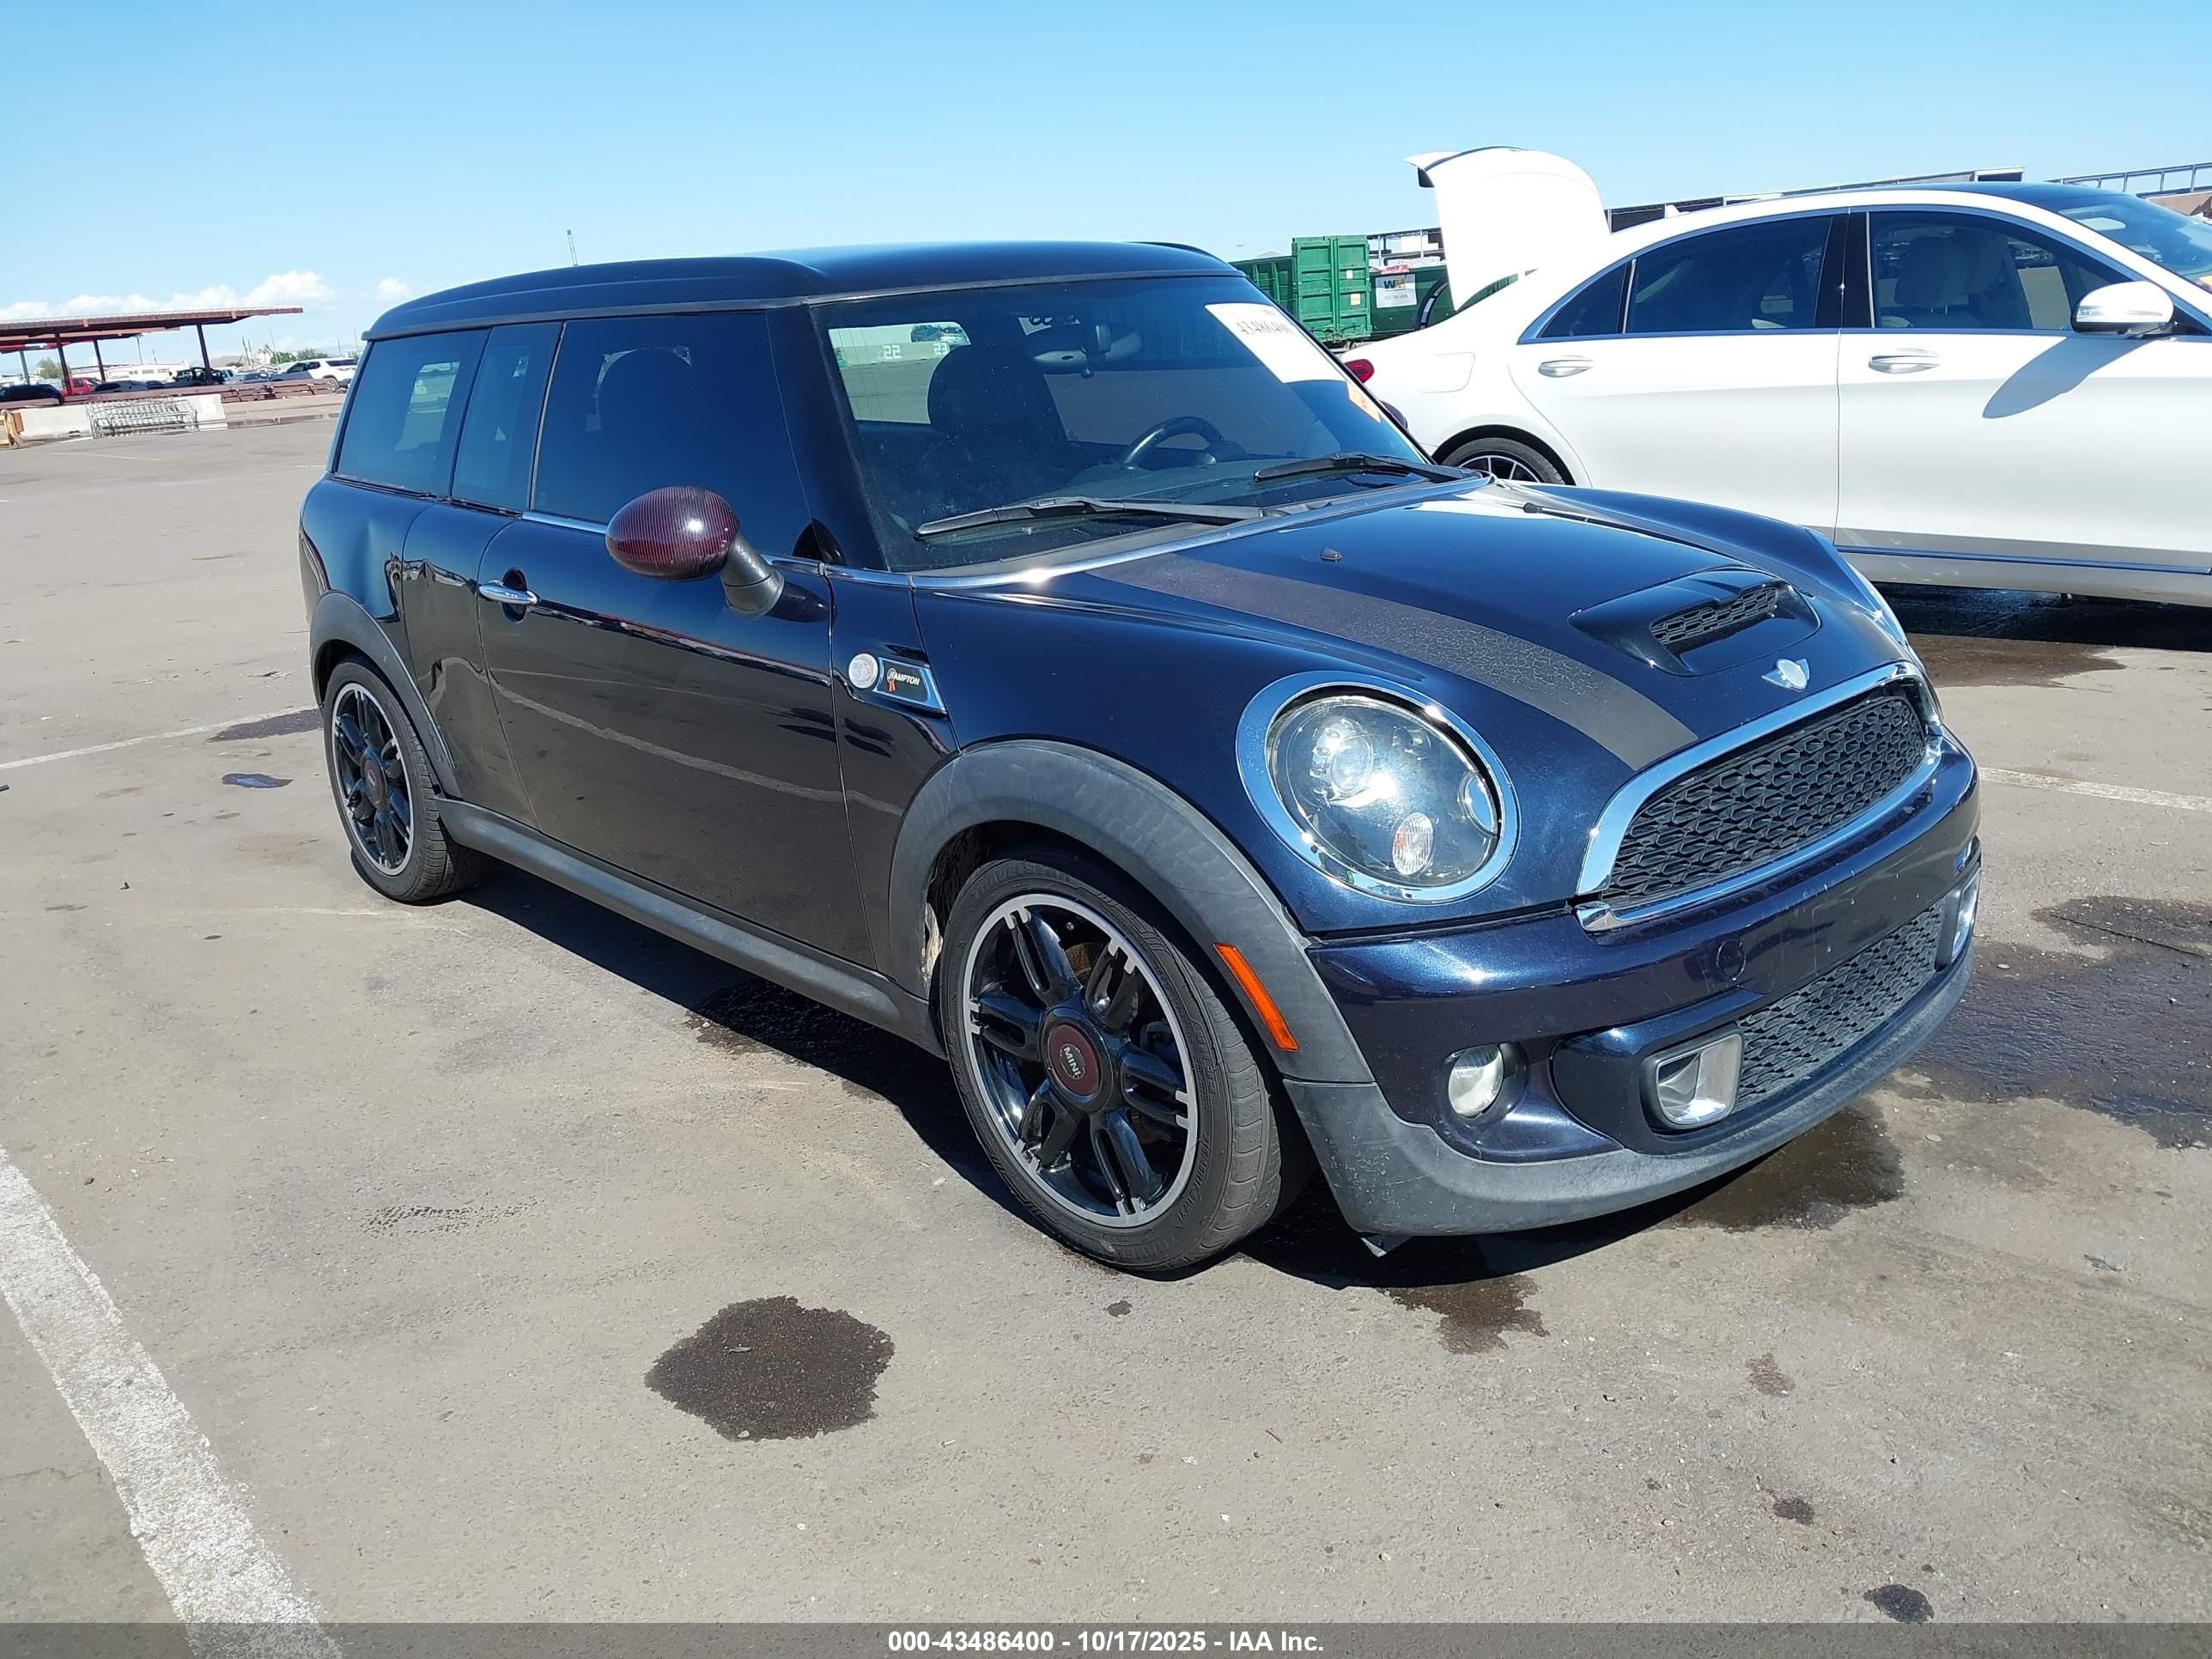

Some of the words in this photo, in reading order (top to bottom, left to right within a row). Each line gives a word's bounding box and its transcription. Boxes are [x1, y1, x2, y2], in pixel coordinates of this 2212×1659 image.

[883, 344, 902, 360] 22
[933, 342, 948, 356] 23
[889, 672, 920, 685] HAMPTON
[1064, 1047, 1081, 1076] MINI
